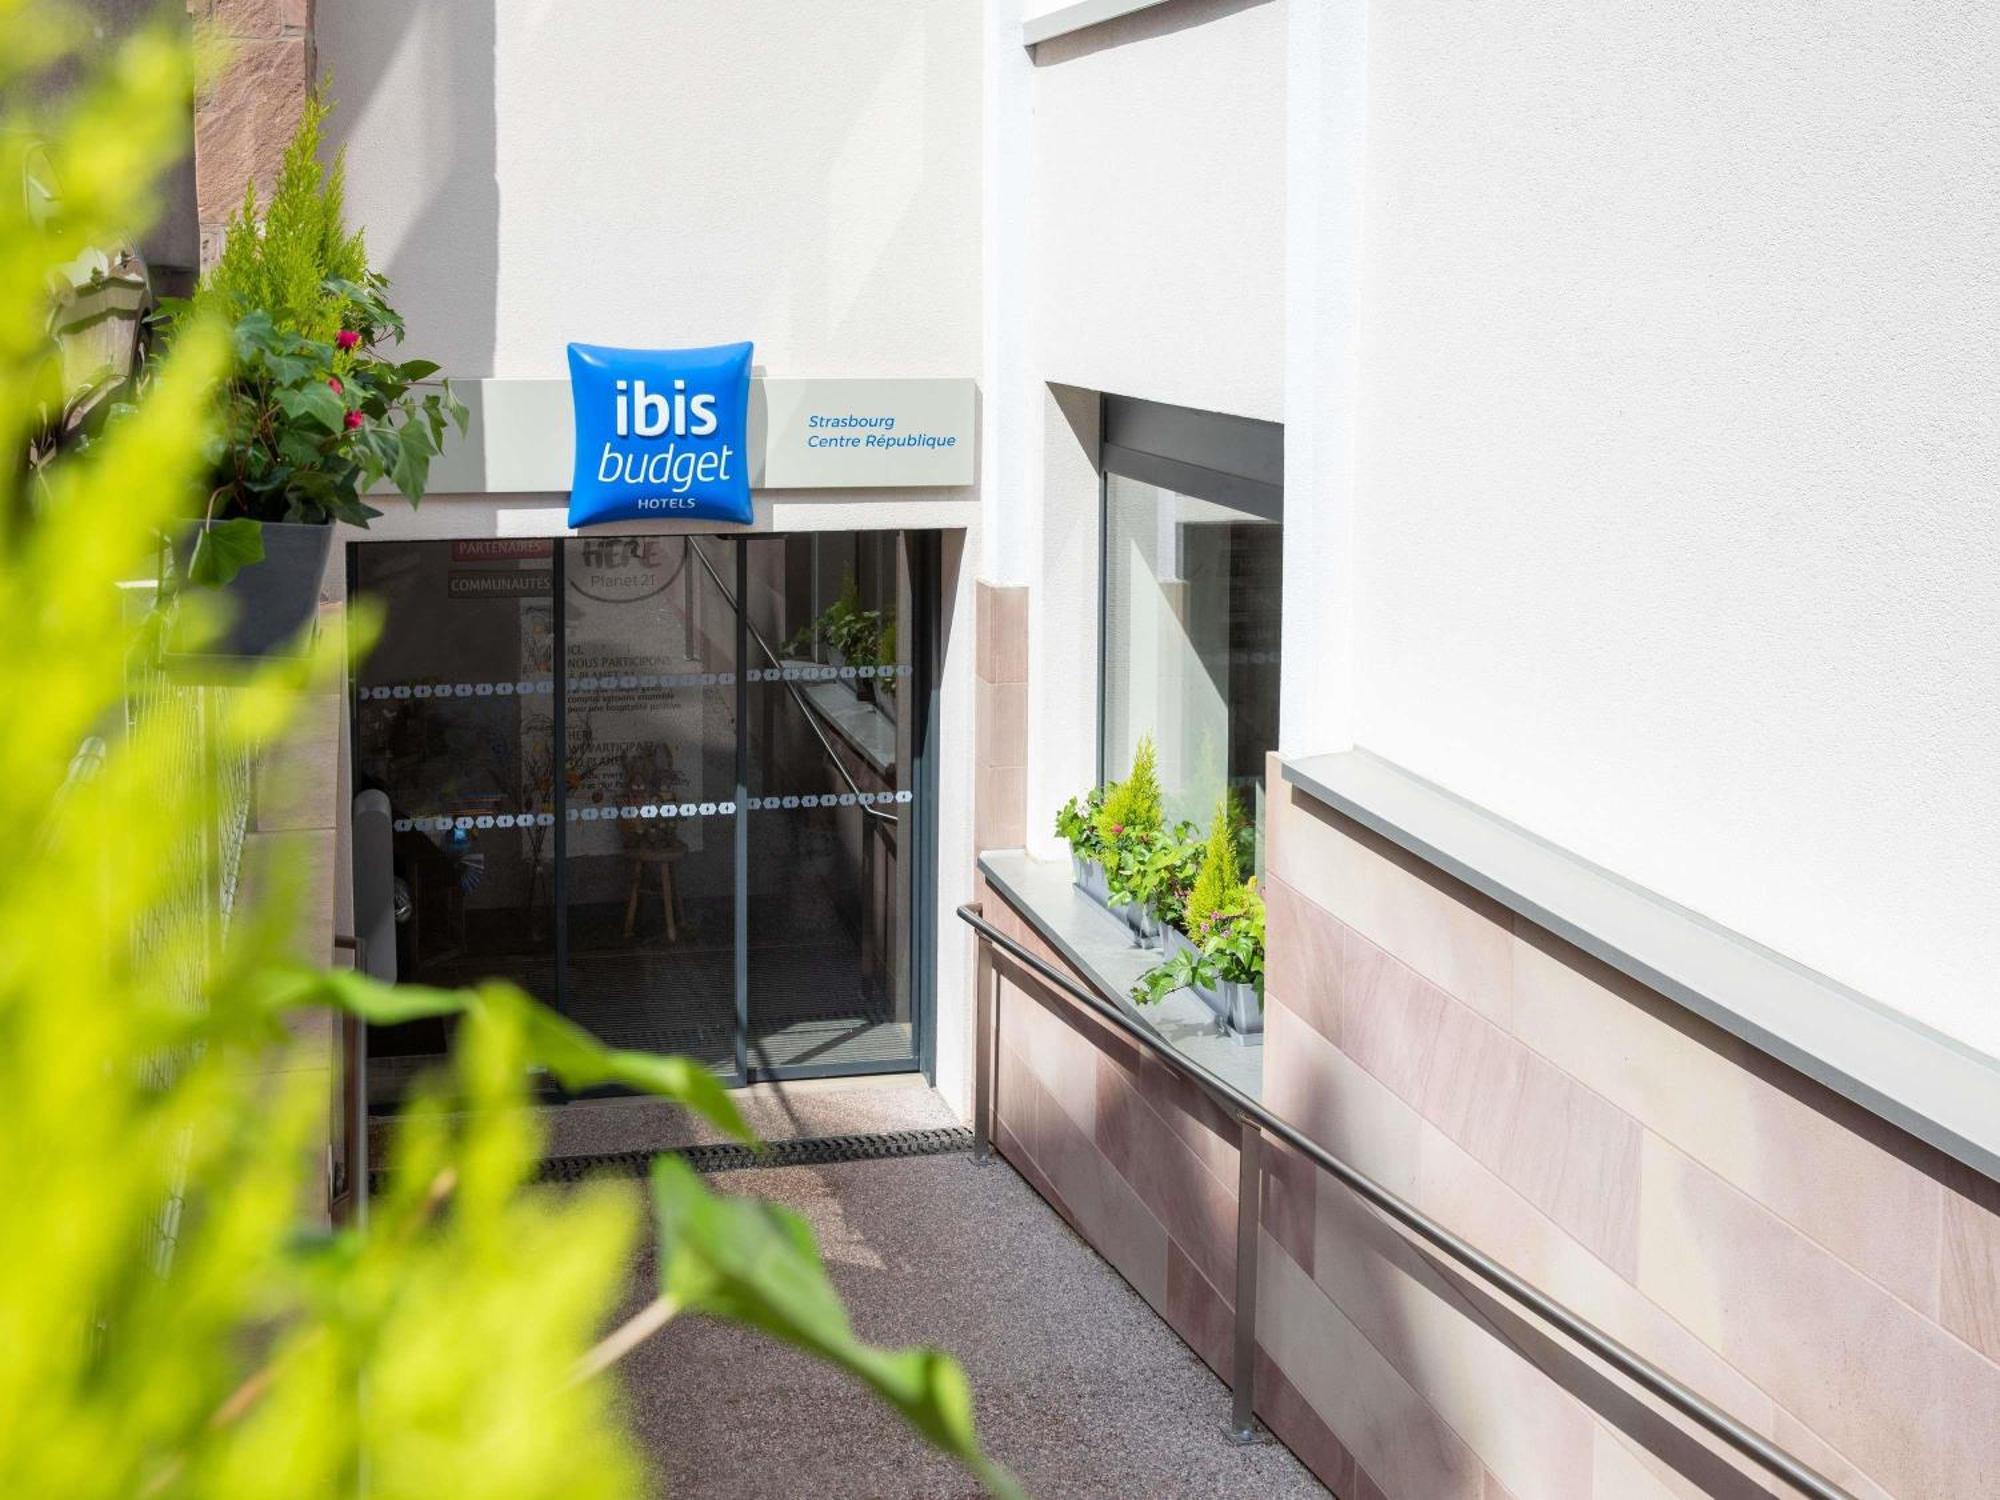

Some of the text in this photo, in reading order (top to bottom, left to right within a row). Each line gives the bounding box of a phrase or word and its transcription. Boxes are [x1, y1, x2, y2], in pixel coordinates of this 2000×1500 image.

[615, 380, 718, 437] ibis
[808, 415, 896, 430] Strasbourg
[807, 434, 956, 449] Centre République
[597, 443, 733, 493] budget
[637, 497, 696, 509] HOTELS
[458, 541, 542, 555] PARTENAIRES
[591, 574, 656, 587] Planet 21
[567, 656, 599, 669] NOUS
